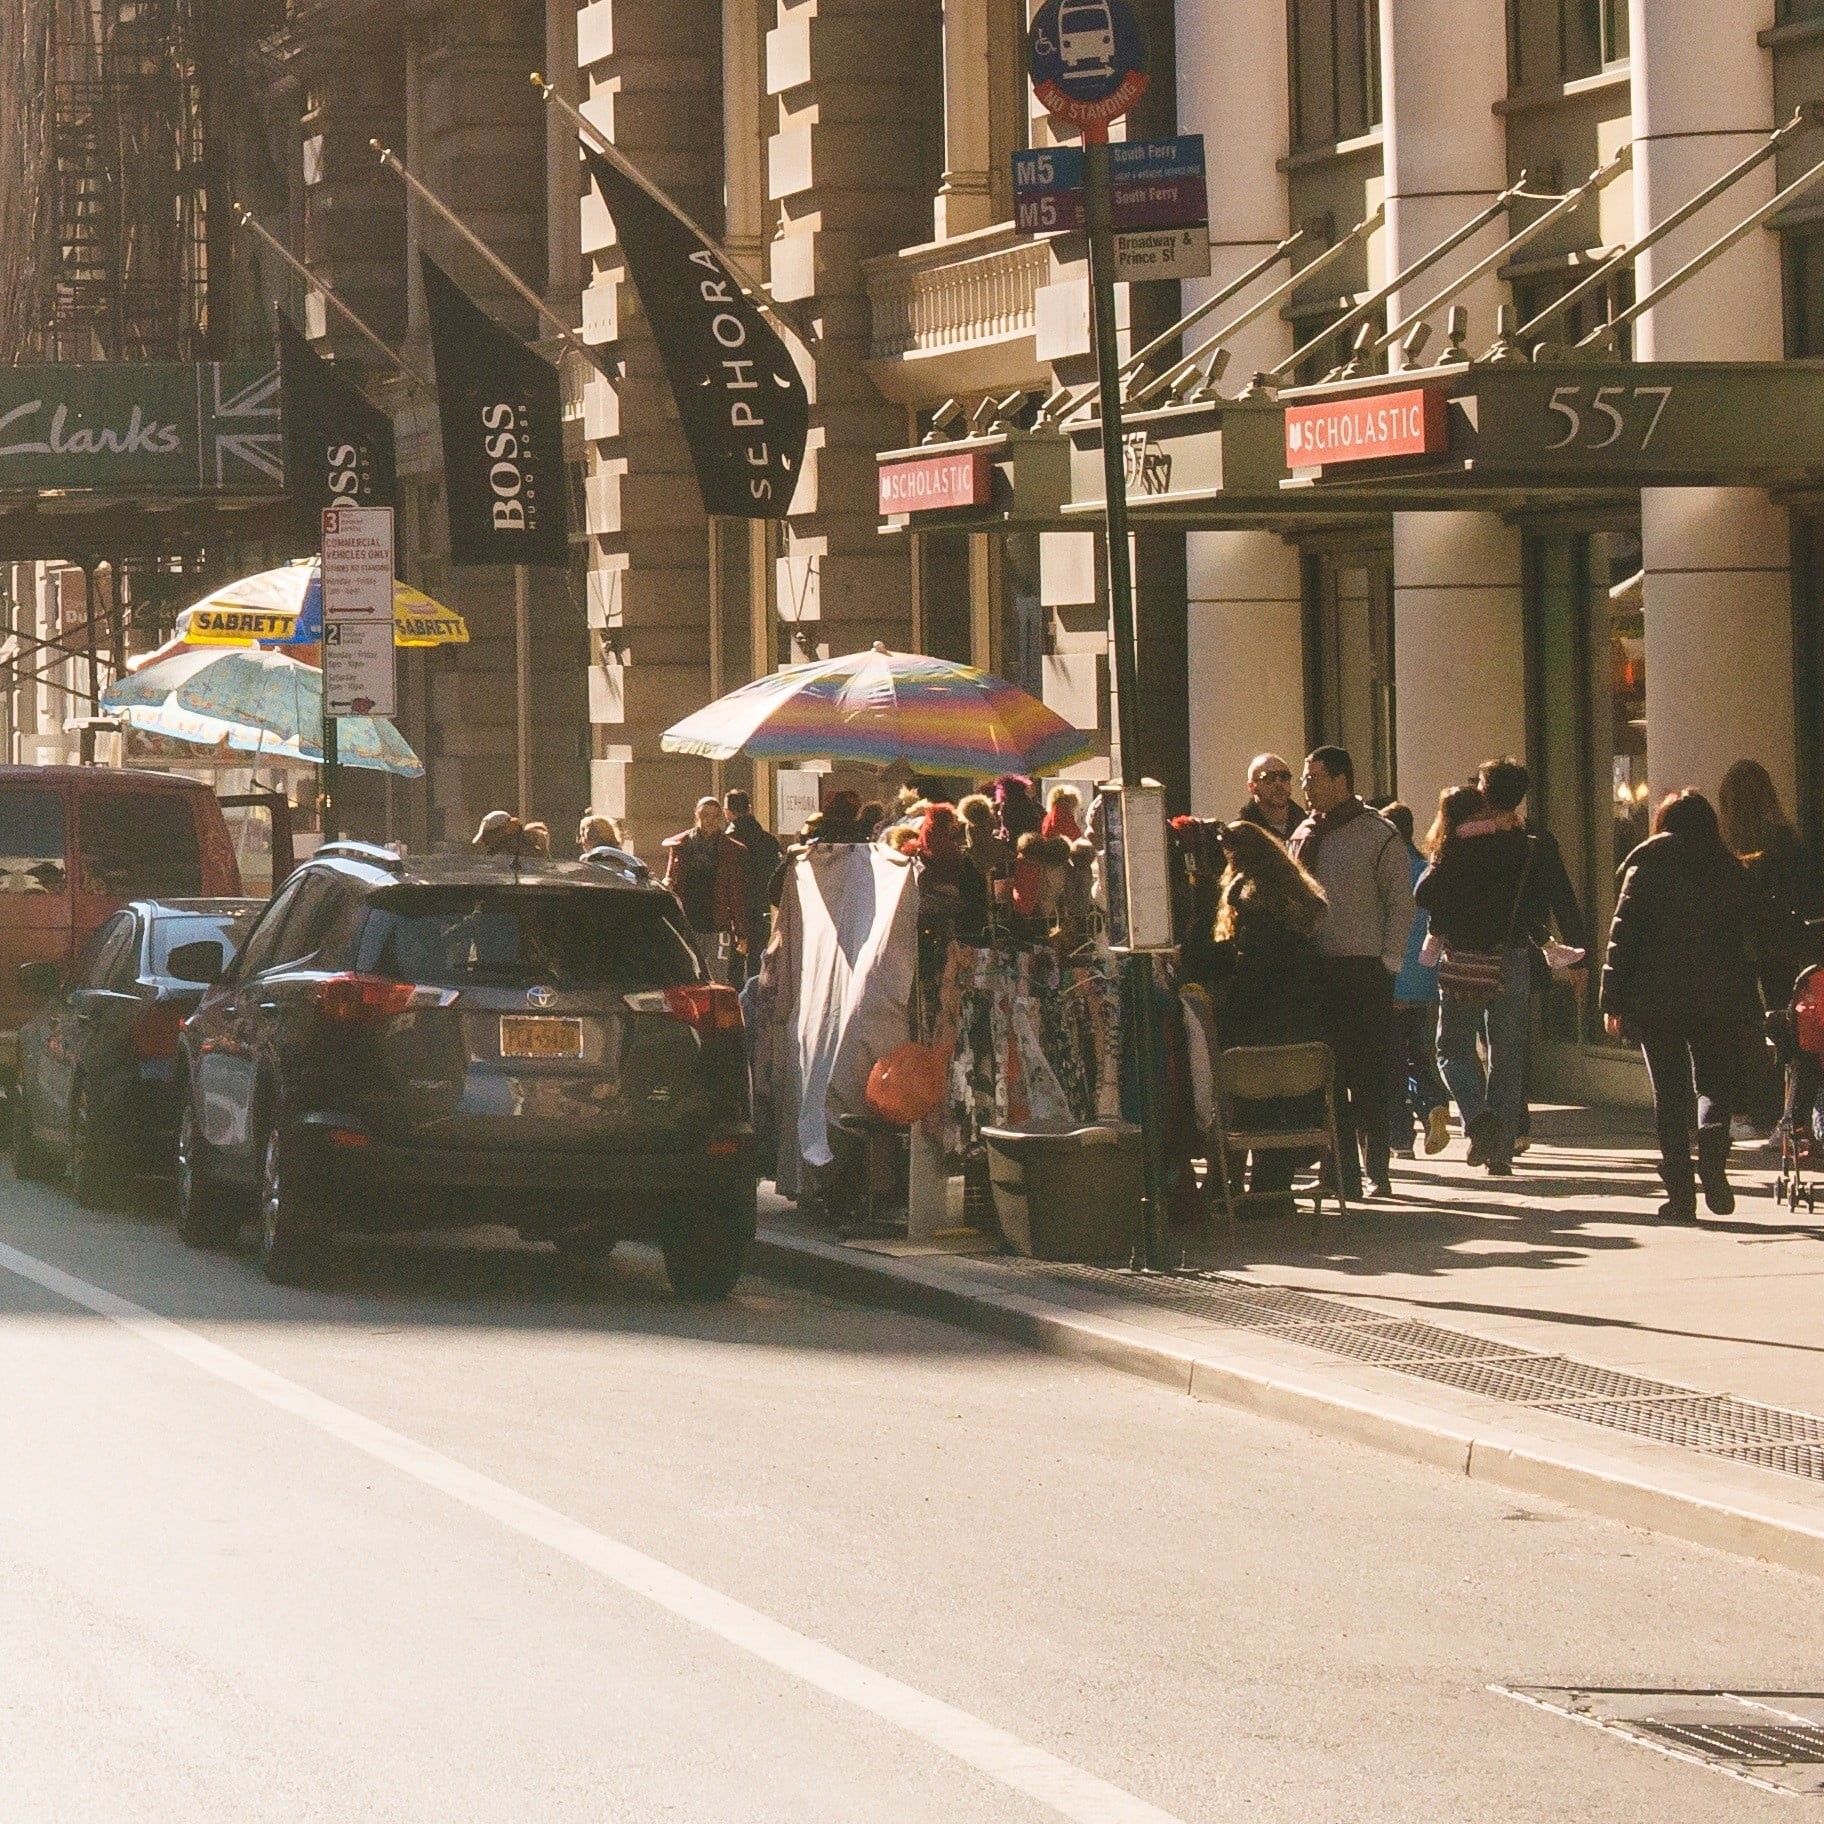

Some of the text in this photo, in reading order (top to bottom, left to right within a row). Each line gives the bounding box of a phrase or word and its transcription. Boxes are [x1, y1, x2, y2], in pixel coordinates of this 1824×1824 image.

[1043, 80, 1138, 120] NO STANDING
[1114, 144, 1178, 163] South Ferry
[1017, 155, 1055, 185] M5
[1115, 187, 1178, 204] South Ferry
[1020, 197, 1057, 229] M5
[1118, 232, 1192, 250] Broadway &
[1119, 249, 1176, 265] Prince St
[688, 249, 772, 500] SEPHORA
[1304, 405, 1421, 451] SCHOLASTIC
[1546, 386, 1673, 450] 557
[481, 403, 526, 531] BOSS
[890, 464, 971, 500] SCHOLASTIC
[326, 512, 338, 533] 3
[326, 537, 381, 548] COMMERCIAL
[326, 549, 389, 559] VEHICLES ONLY
[197, 612, 294, 634] SABRETT
[327, 624, 338, 643] 2
[394, 617, 465, 639] SABRETT
